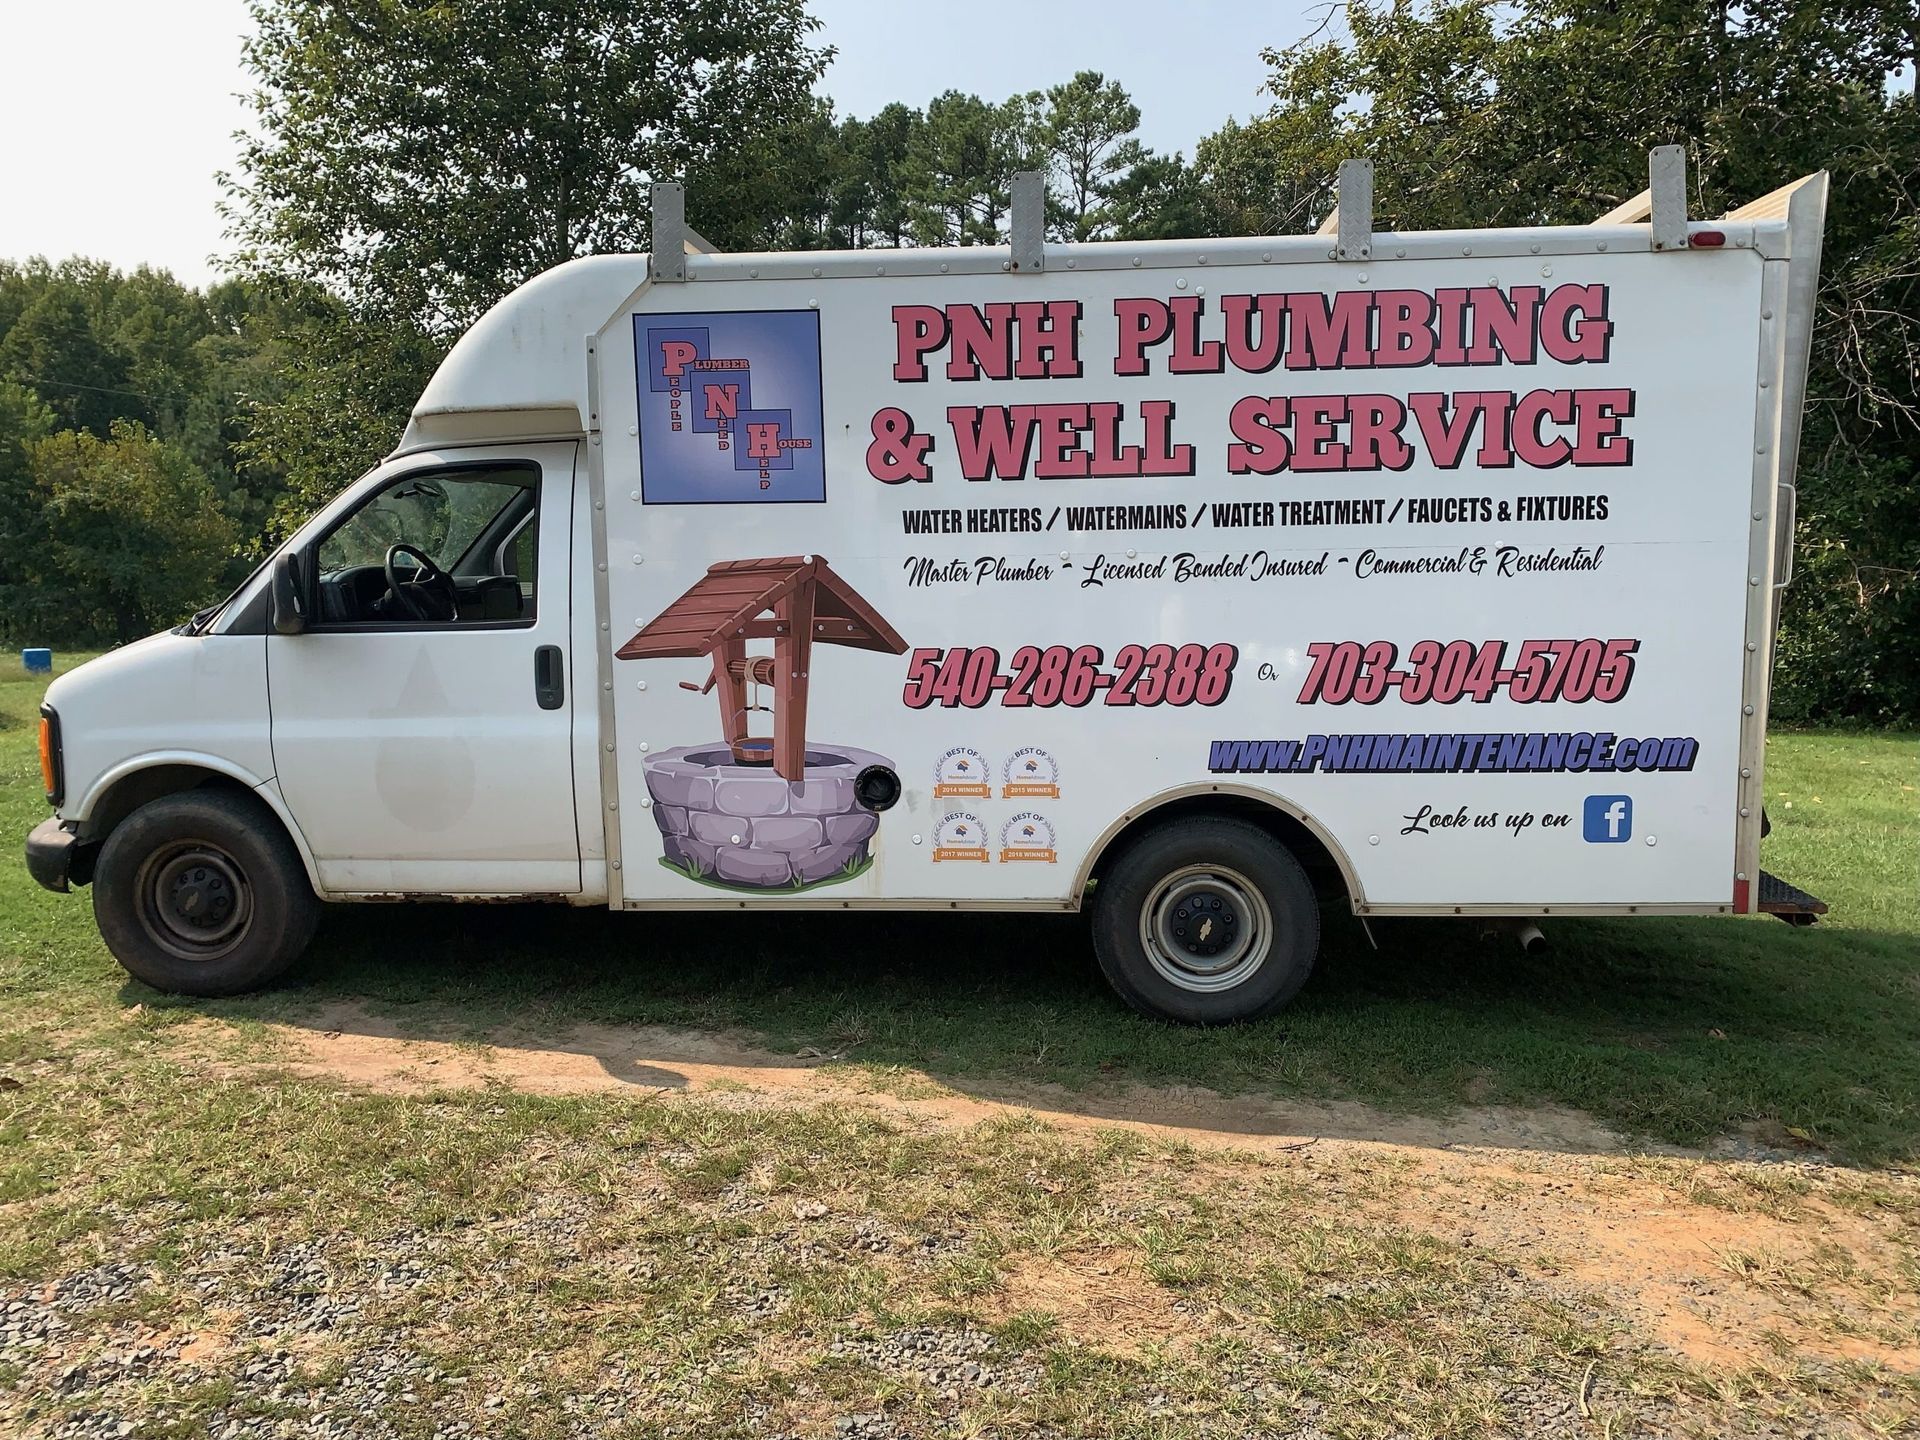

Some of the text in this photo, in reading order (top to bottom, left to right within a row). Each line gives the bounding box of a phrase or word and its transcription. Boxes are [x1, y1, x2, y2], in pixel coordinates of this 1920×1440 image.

[892, 283, 1614, 382] PNH PLUMBING
[865, 388, 1636, 485] & WELL SERVICE
[902, 509, 962, 534] WATER
[967, 507, 1042, 533] HEATERS
[1066, 503, 1187, 531] WATERMAINS
[1211, 501, 1274, 528] WATER
[1279, 498, 1386, 525] TREATMENT
[1407, 497, 1492, 523] FAUCETS
[1496, 500, 1512, 522] &
[1516, 494, 1609, 521] FIXTURES
[903, 555, 972, 588] Master
[974, 556, 1054, 586] Plumber
[1080, 554, 1167, 589] Licensed
[1170, 551, 1250, 583] Bonded
[1249, 549, 1329, 582] Insured
[1355, 547, 1470, 579] Commercial
[1468, 547, 1489, 578] &
[1496, 544, 1606, 578] Residential
[902, 638, 1641, 710] 540-286-2388 Or 703-304-5705
[946, 747, 979, 759] BEST OF
[1014, 747, 1048, 759] BEST OF
[1207, 732, 1700, 774] www.PNHMAINTENANCE.com
[944, 812, 977, 823] BEST OF
[1011, 813, 1045, 824] BEST OF
[1400, 804, 1471, 835] Look
[1473, 812, 1500, 828] us
[1504, 811, 1535, 838] up
[1541, 813, 1573, 828] on
